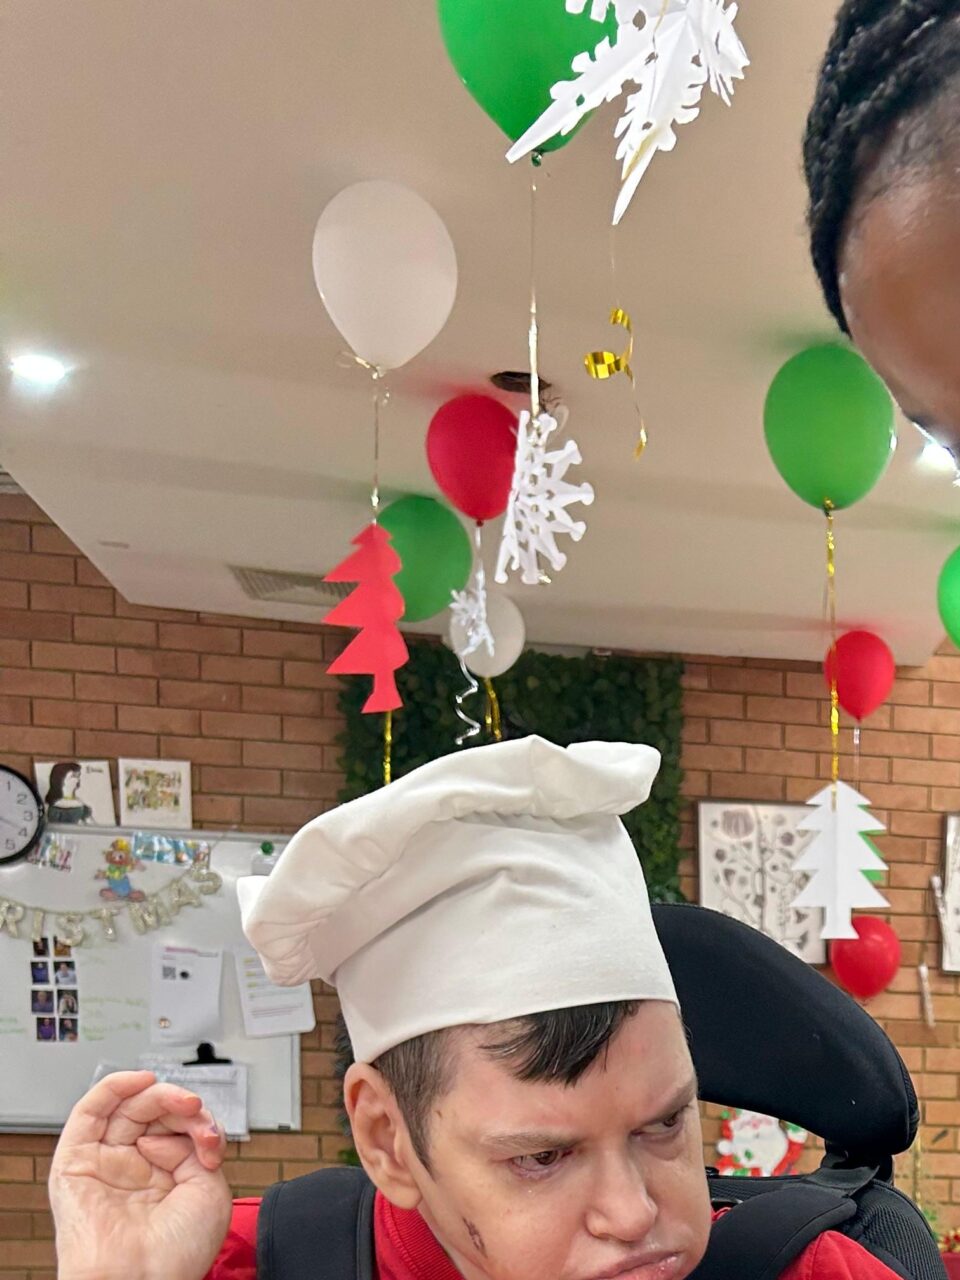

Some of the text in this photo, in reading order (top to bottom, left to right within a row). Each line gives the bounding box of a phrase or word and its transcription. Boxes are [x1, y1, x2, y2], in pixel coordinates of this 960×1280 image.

[16, 793, 28, 806] 2
[23, 810, 34, 822] 3
[18, 827, 28, 837] 4
[5, 839, 16, 850] 5
